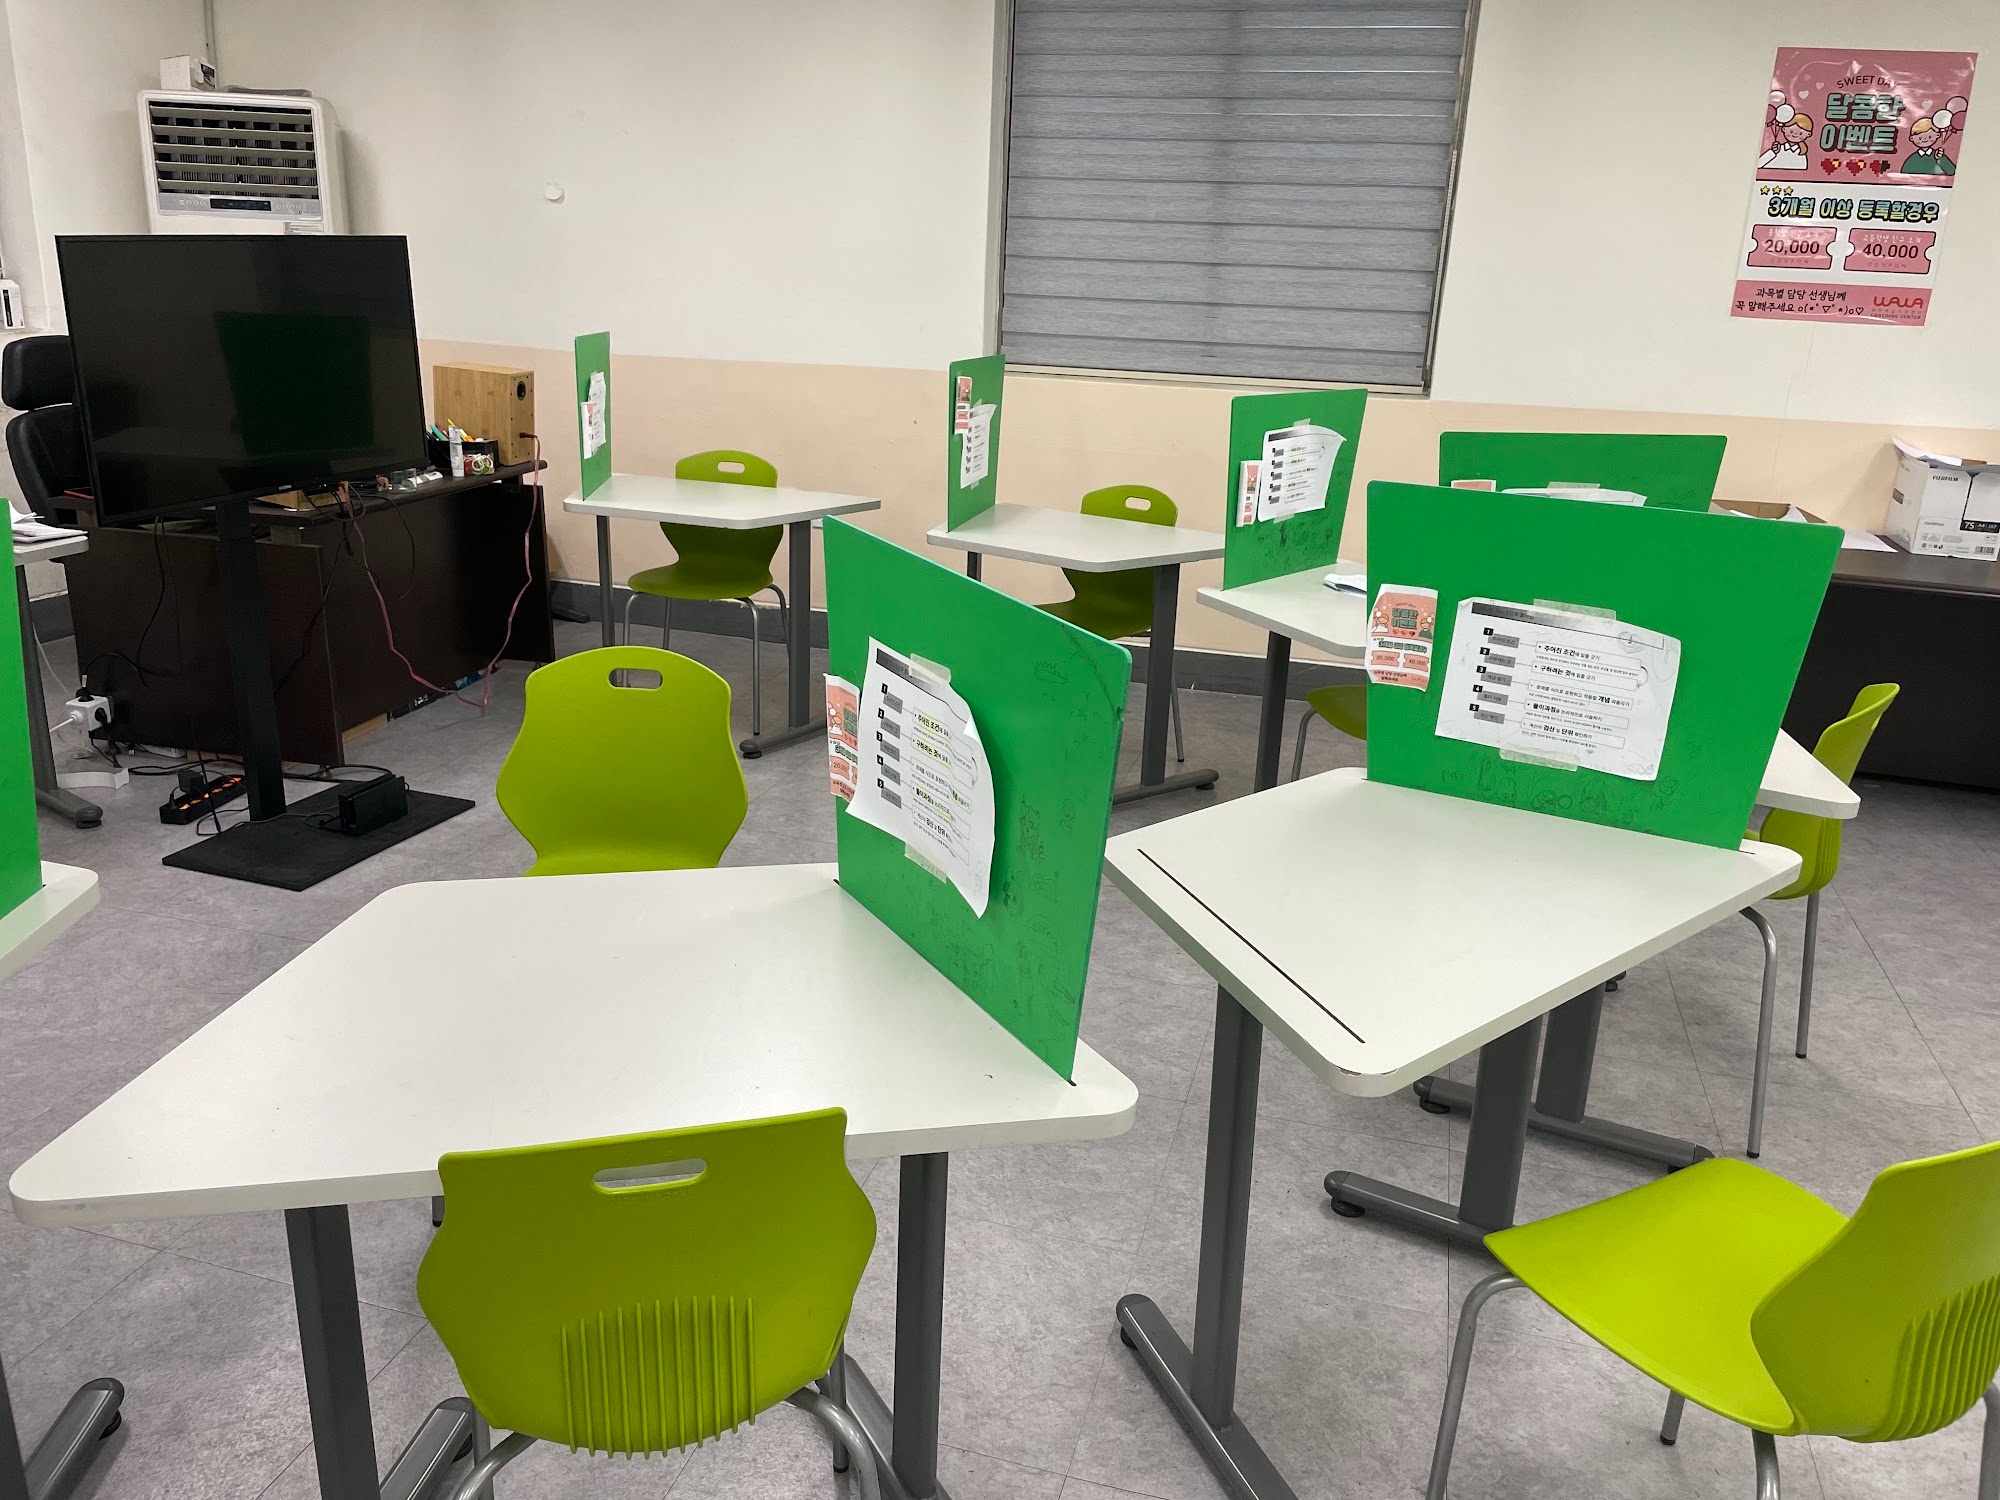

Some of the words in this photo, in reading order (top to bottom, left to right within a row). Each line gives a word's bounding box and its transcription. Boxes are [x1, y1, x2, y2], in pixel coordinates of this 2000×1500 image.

[1837, 75, 1875, 89] SWEET
[1825, 93, 1906, 123] 달콤한
[1819, 124, 1899, 154] 이벤트
[1768, 197, 1815, 217] 3개월
[1820, 198, 1853, 219] 이상
[1764, 239, 1820, 255] 20,000
[1862, 243, 1919, 259] 40,000
[1867, 261, 1907, 269] COUPON
[1755, 288, 1784, 299] 과목별
[1787, 289, 1806, 300] 담당
[1808, 291, 1847, 302] 선생님께
[1735, 300, 1746, 311] 꼭
[1748, 301, 1795, 313] 말해주세요
[1964, 521, 1975, 530] 75
[1544, 645, 1562, 655] 주어진
[1540, 664, 1564, 676] 구하려는
[1598, 695, 1611, 704] 개념
[1533, 702, 1560, 714] 풀이과정을
[917, 714, 930, 728] 주어진
[1543, 724, 1555, 733] 검산
[1561, 727, 1574, 737] 단위
[916, 739, 933, 756] 구하려는
